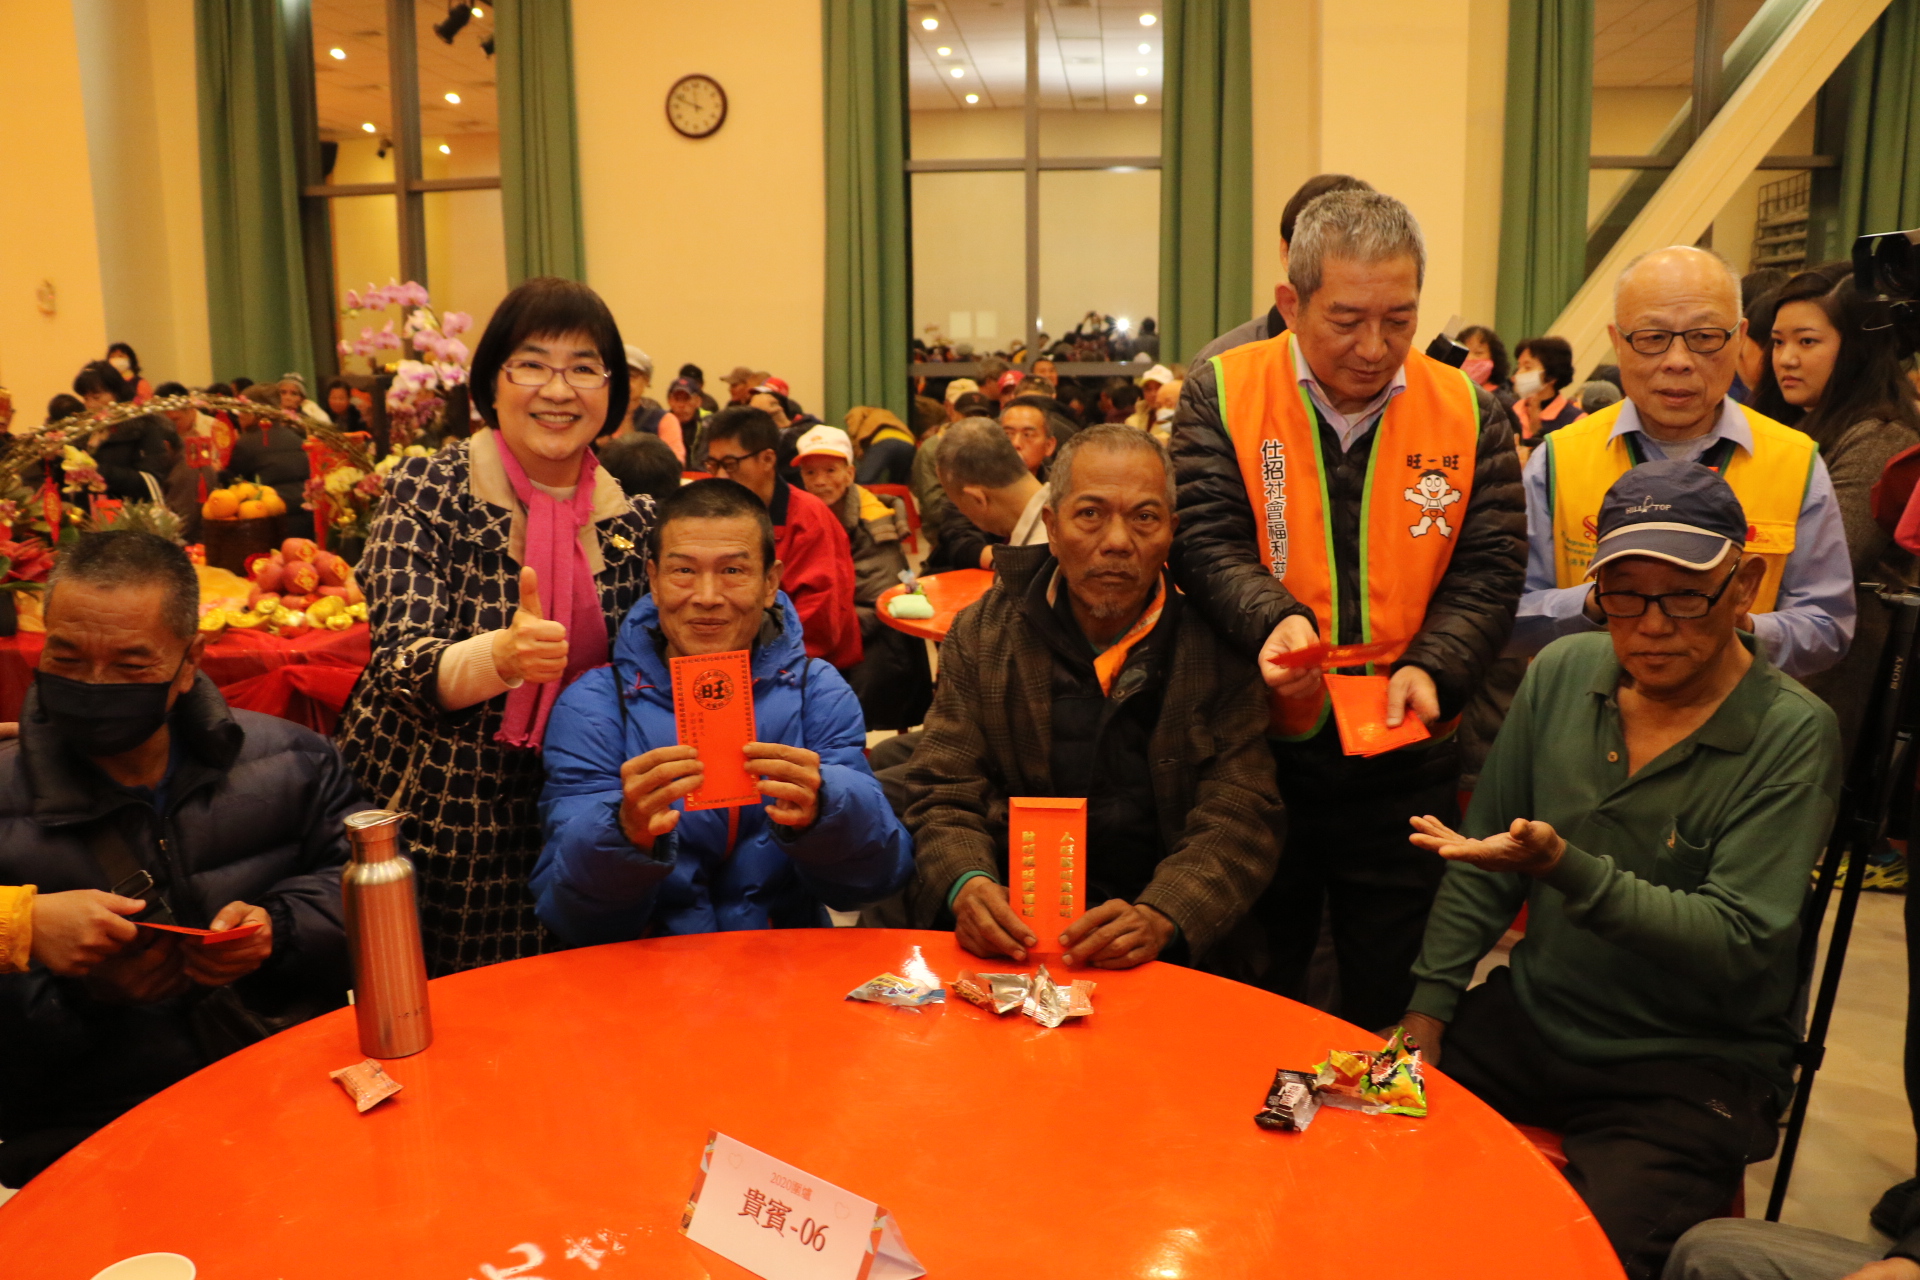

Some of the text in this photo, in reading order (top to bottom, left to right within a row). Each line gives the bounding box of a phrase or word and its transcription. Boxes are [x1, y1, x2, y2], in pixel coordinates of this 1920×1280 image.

[1653, 503, 1672, 511] TOP
[1890, 656, 1904, 690] SONY
[702, 679, 725, 699] 旺
[738, 1187, 829, 1252] 貴賓-06
